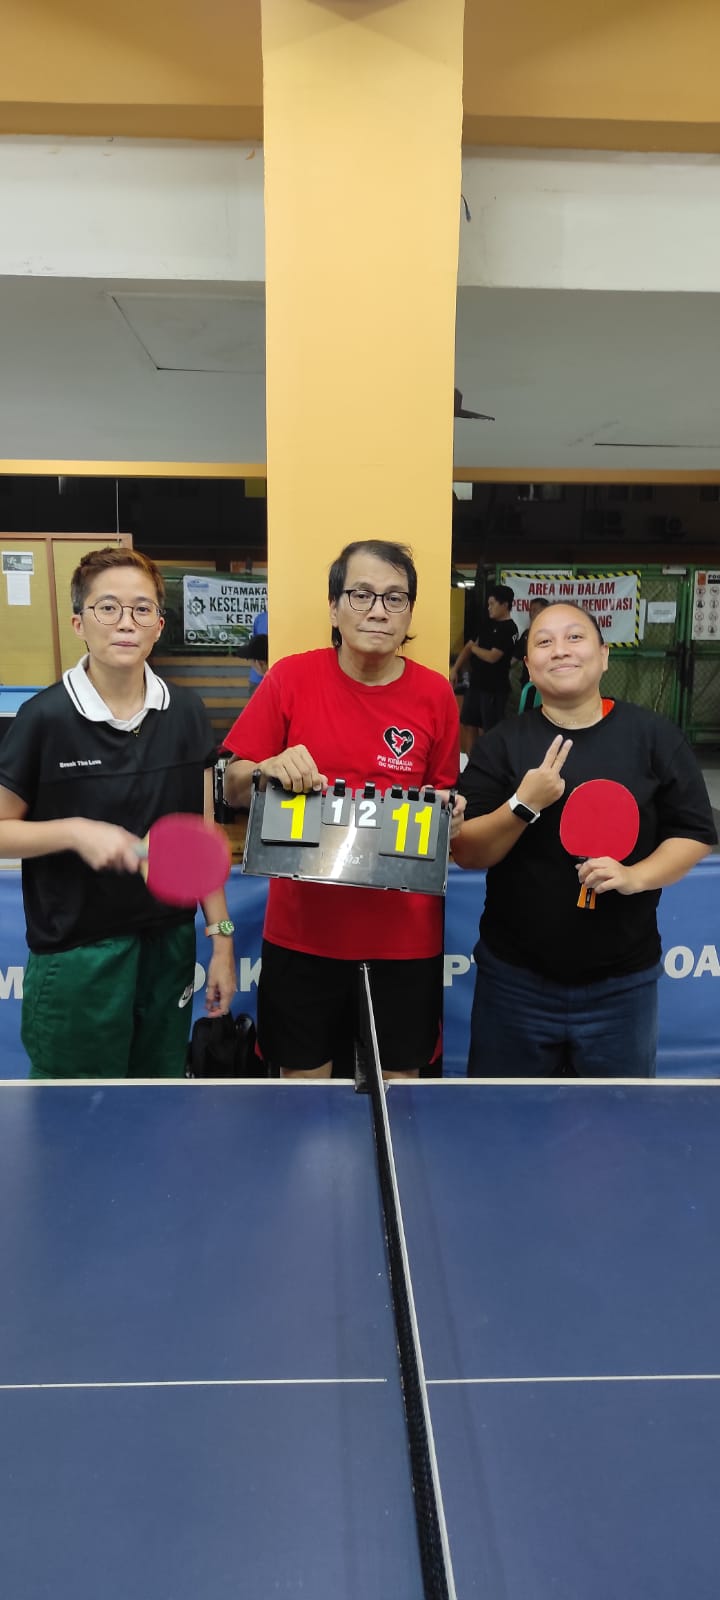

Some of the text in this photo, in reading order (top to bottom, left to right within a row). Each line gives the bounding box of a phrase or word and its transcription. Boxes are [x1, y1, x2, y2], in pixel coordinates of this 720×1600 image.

[221, 585, 268, 596] UTAMAKA
[528, 582, 615, 596] AREA INI DALAM
[209, 596, 268, 613] KESELAMA
[582, 597, 633, 612] RENOVASI
[226, 613, 253, 624] KER
[280, 795, 433, 856] 1 1 2 11
